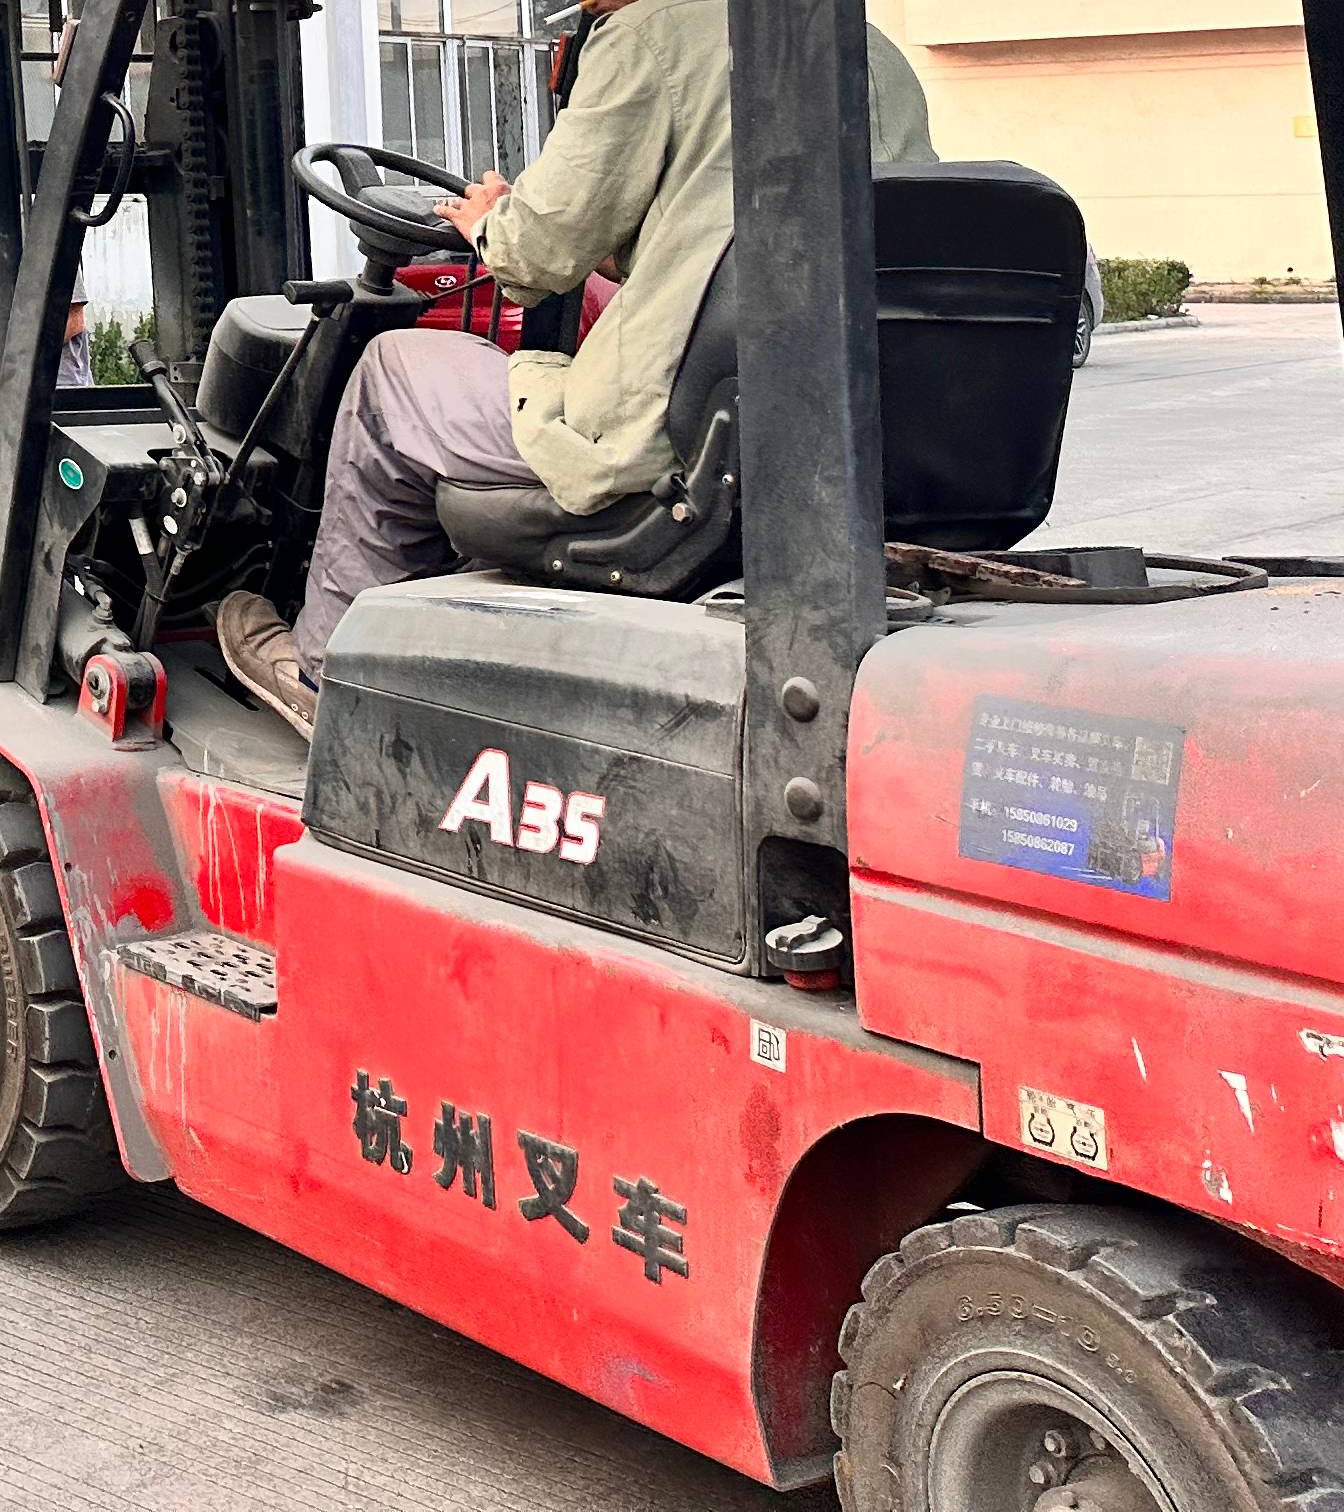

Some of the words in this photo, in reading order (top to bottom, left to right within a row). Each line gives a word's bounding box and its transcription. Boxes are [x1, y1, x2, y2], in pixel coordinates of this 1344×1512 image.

[437, 745, 608, 866] A35
[349, 1067, 691, 1285] 杭州叉车
